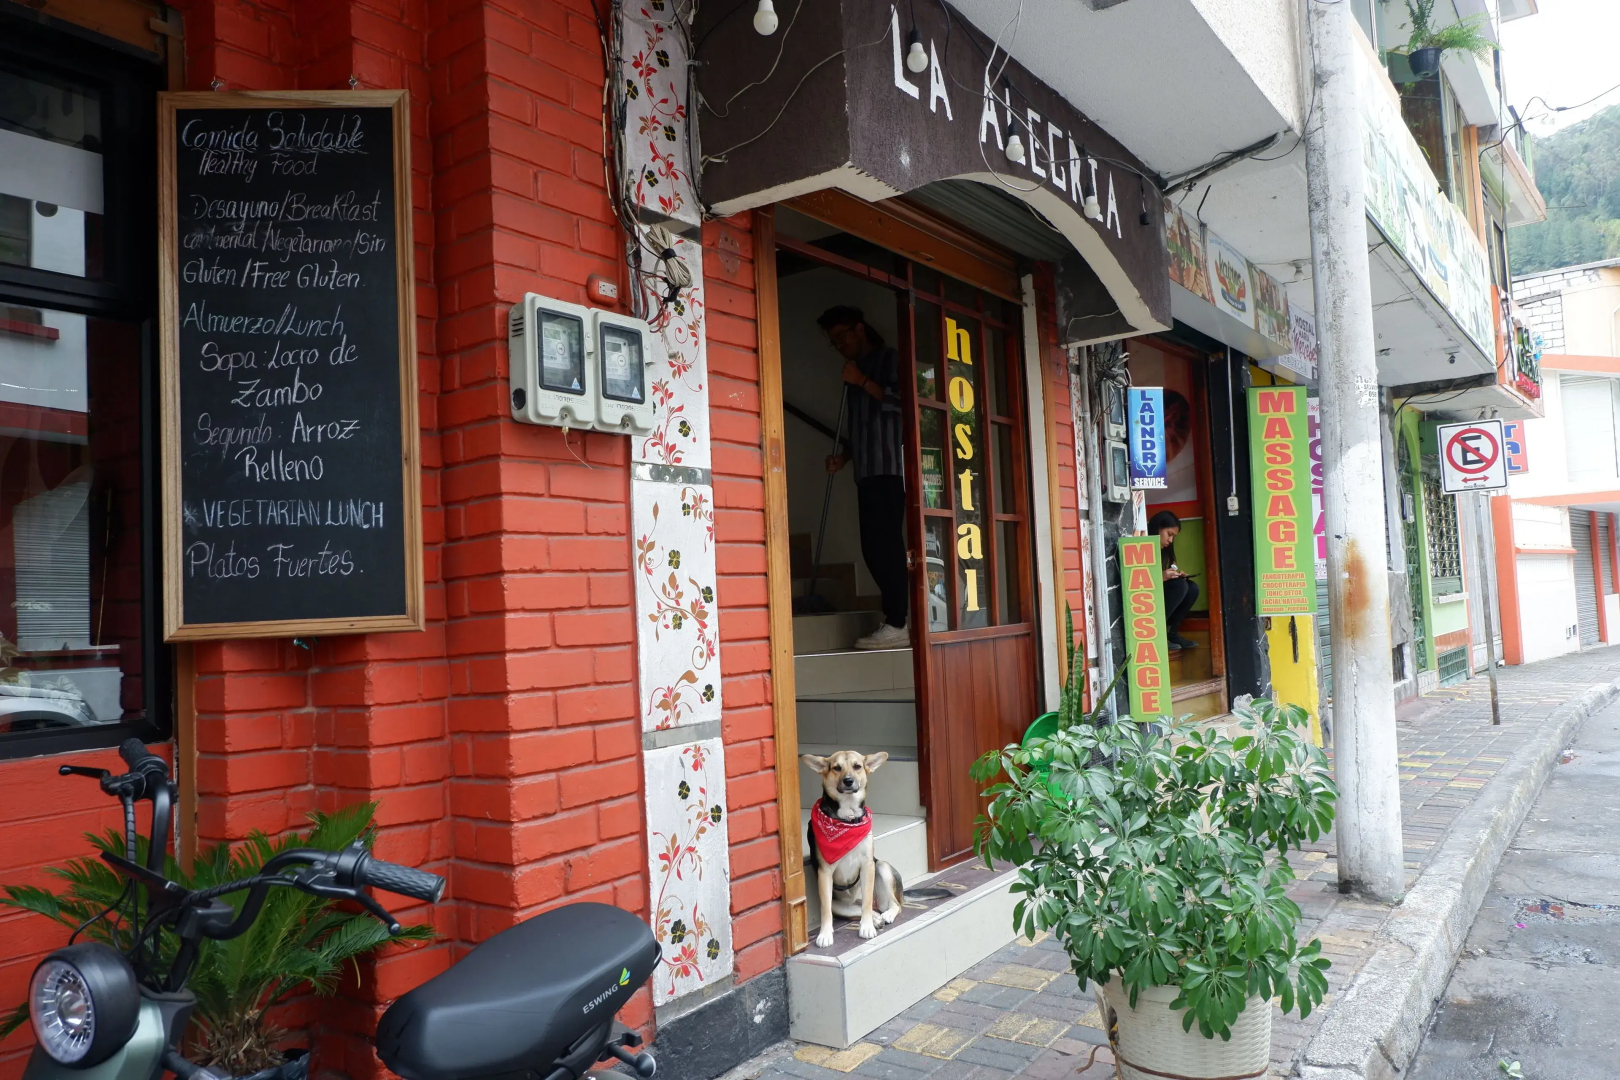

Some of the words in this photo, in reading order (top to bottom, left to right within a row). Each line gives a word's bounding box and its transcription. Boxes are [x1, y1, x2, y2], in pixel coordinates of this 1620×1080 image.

[891, 4, 953, 121] LA
[182, 115, 259, 148] Comida
[267, 111, 364, 149] Saludable
[199, 150, 257, 182] Healthy
[271, 150, 317, 175] Food
[329, 334, 358, 366] de
[231, 367, 323, 407] Zambo
[292, 411, 361, 443] Arroz
[1139, 390, 1157, 476] LAUNDRY
[235, 445, 323, 482] Relleno
[945, 316, 984, 612] hostal
[1460, 434, 1485, 466] E
[1134, 477, 1165, 487] SERVICE
[1258, 390, 1297, 569] MASSAGE
[203, 498, 320, 529] VEGETARIAN
[325, 498, 384, 529] LUNCH
[186, 540, 260, 578] Platos
[1123, 543, 1161, 713] MASSAGE
[582, 983, 619, 1014] ESWING
